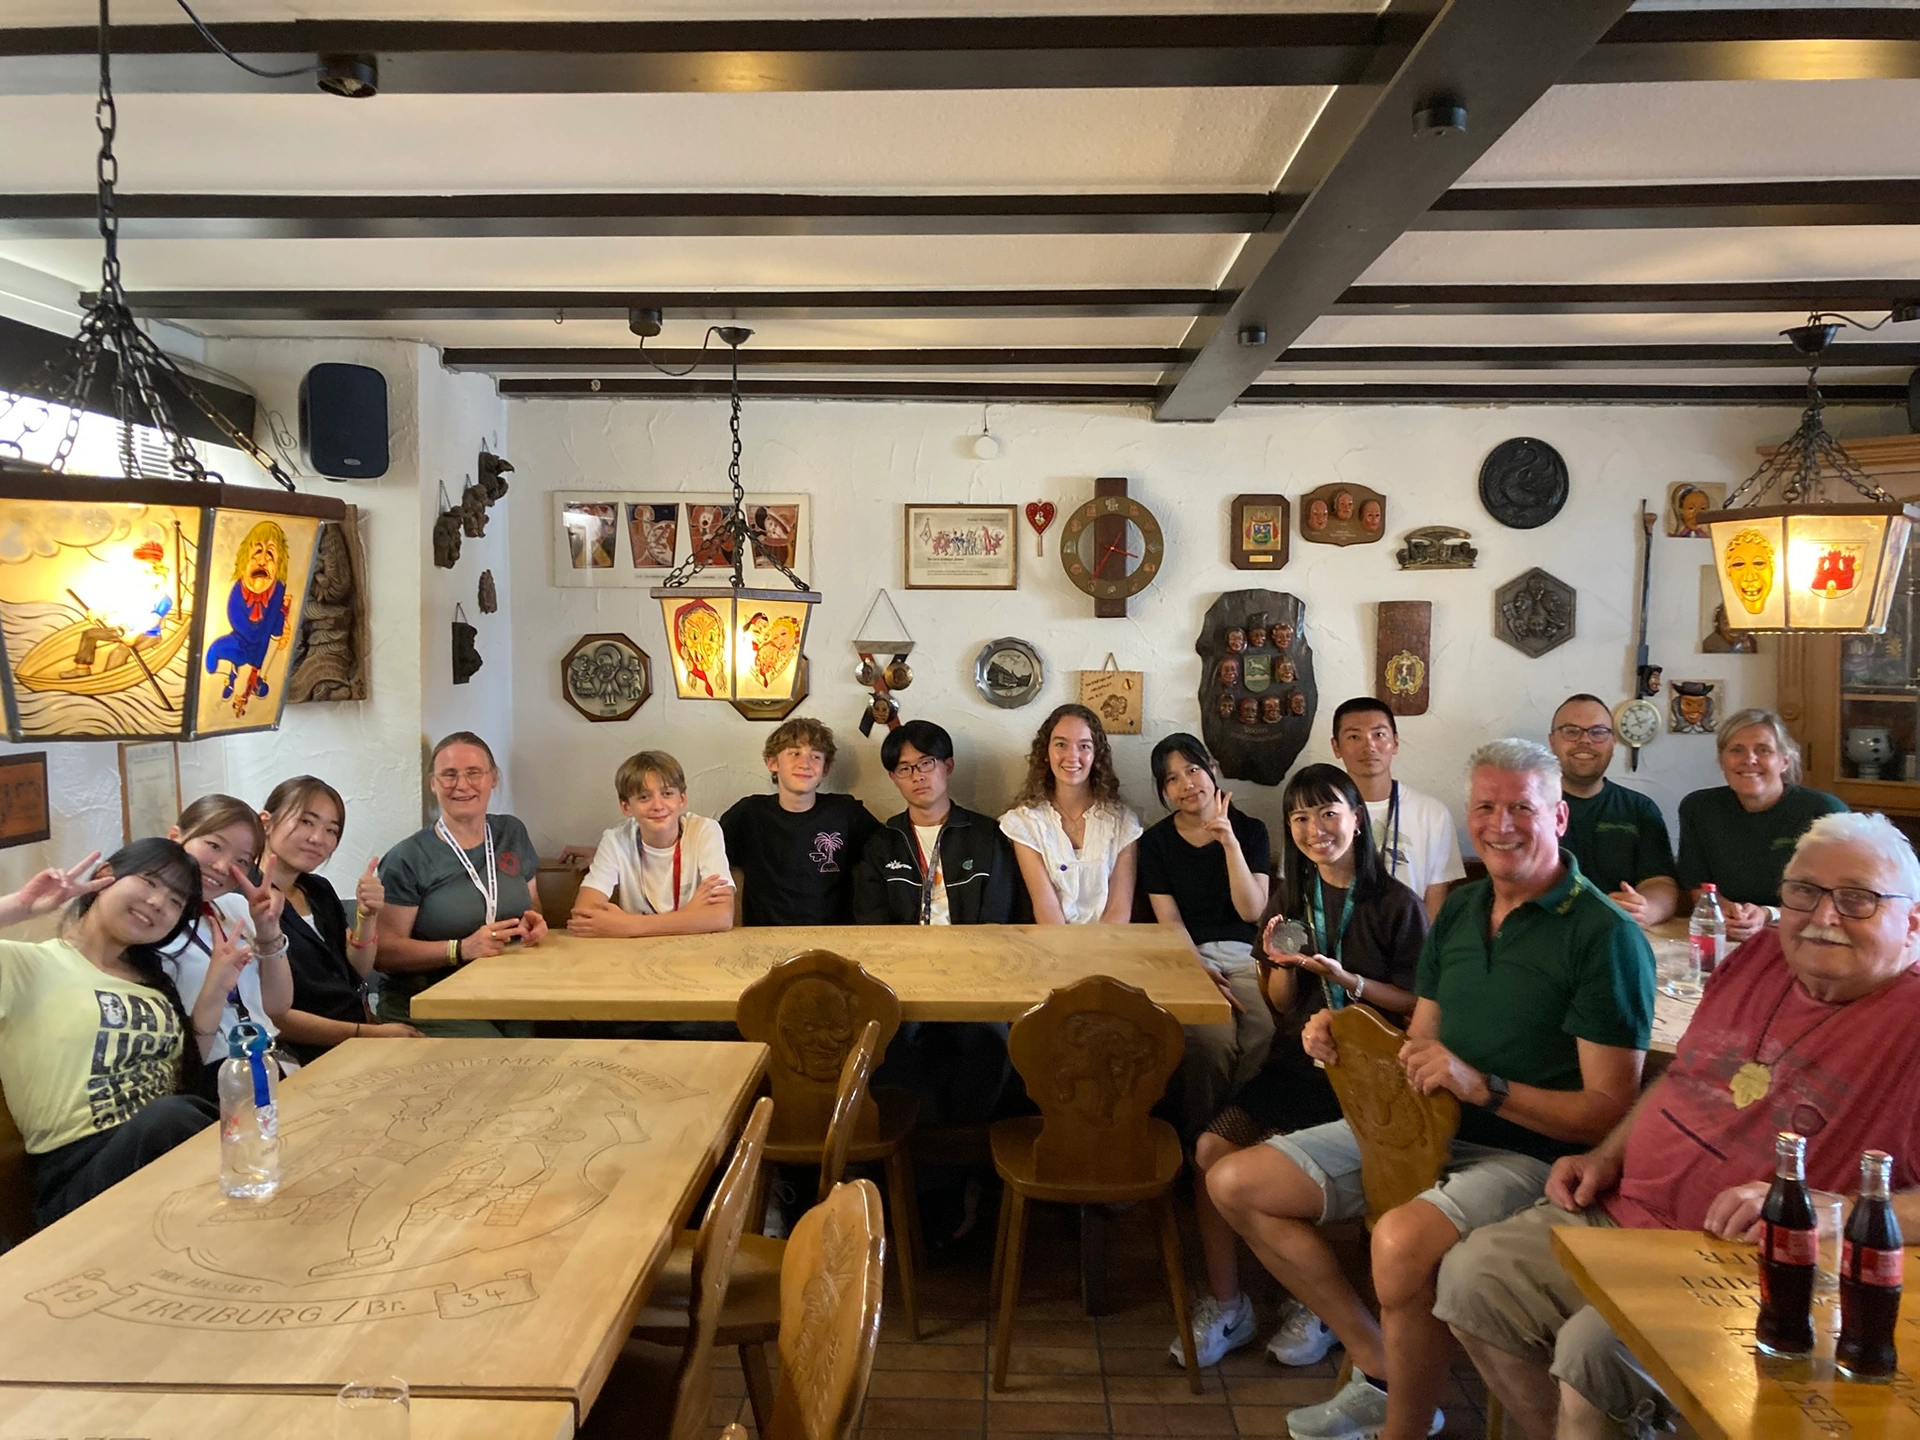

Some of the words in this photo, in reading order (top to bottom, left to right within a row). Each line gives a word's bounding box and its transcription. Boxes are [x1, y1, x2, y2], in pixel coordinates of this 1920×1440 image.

[53, 1284, 99, 1303] 19
[461, 1287, 506, 1308] 34
[128, 1298, 323, 1326] FREIBURG
